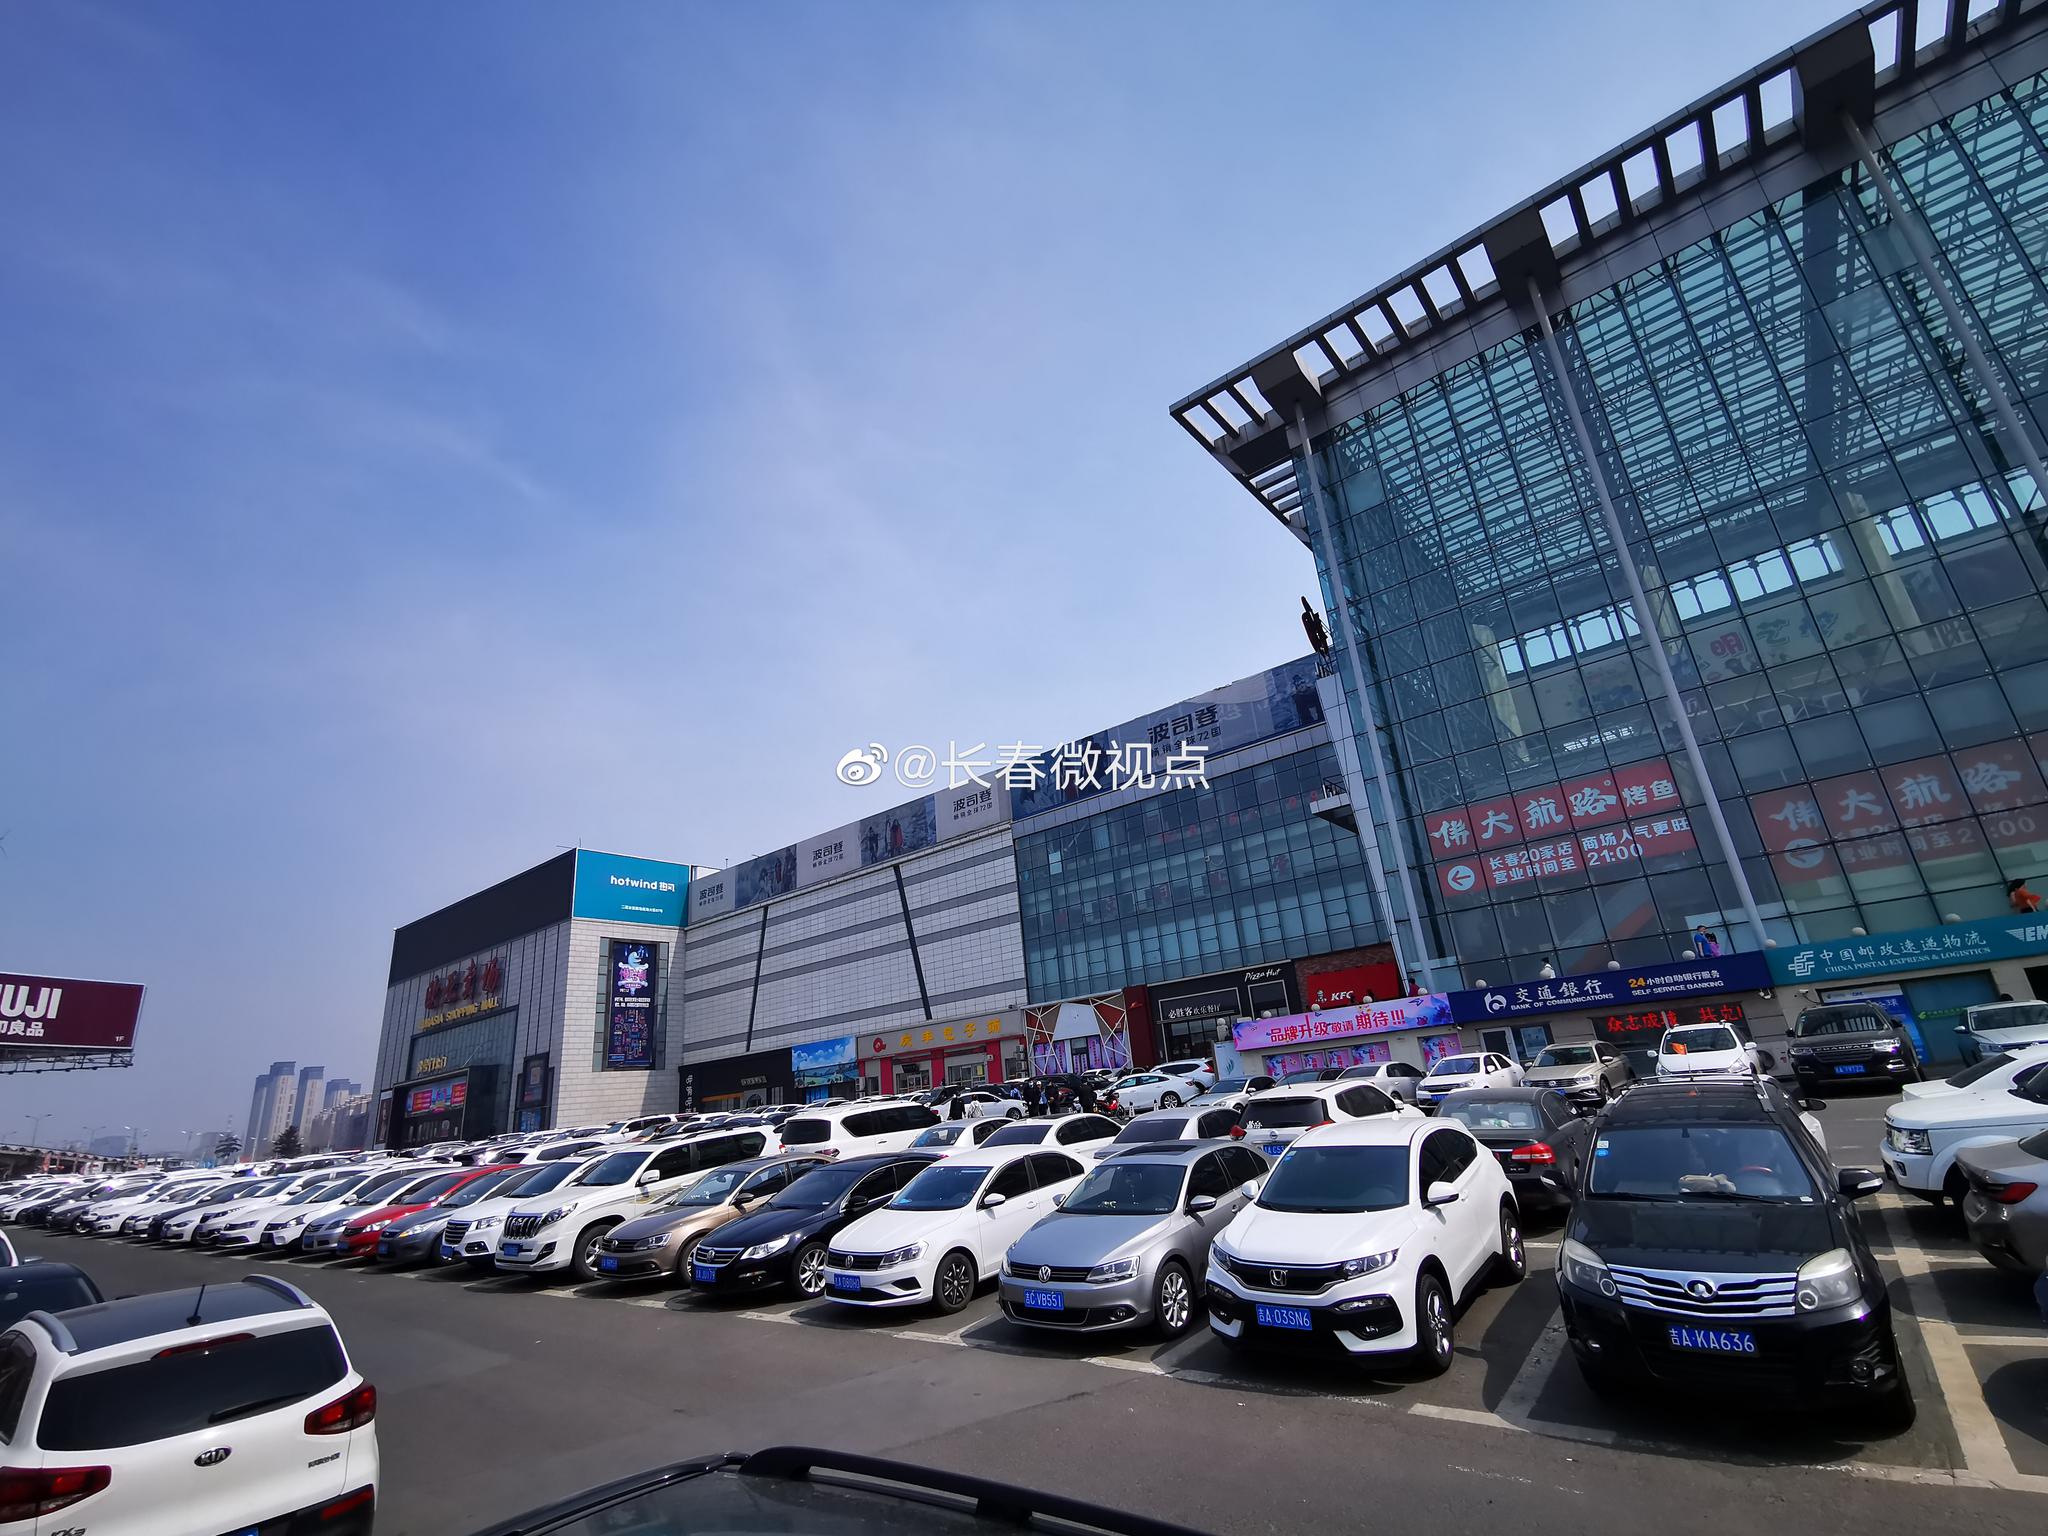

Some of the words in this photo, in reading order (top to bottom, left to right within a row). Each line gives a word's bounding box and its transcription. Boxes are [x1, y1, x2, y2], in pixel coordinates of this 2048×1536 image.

[1147, 704, 1219, 744] 波司登
[953, 788, 992, 812] 波司登
[1769, 762, 2021, 831] 伟大航路
[1430, 786, 1617, 848] 伟大航路
[1621, 778, 1679, 808] 烤鱼
[1956, 815, 2037, 844] 2:00
[812, 840, 844, 861] 波司登
[1488, 841, 1573, 870] 长春20家店
[1581, 817, 1690, 851] 商场人气更旺
[1492, 856, 1578, 885] 营业时间至
[1587, 844, 1643, 866] 21:00
[610, 875, 657, 890] hotwind
[1819, 930, 1987, 965] 中国邮政速递物流
[1825, 964, 1853, 974] CHINA
[1854, 959, 1887, 970] POSTAL
[1889, 955, 1928, 967] EXPRESS
[1940, 946, 1991, 959] LOGISTICS
[1244, 971, 1265, 982] Pizza
[1265, 968, 1281, 977] Hut
[1653, 984, 1686, 994] SERVICE
[1687, 980, 1724, 990] BANKING
[0, 984, 62, 1019] UJI
[481, 996, 499, 1008] MALL
[1331, 990, 1353, 1001] KFC
[1511, 1003, 1531, 1011] BANK
[1546, 993, 1614, 1008] COMMUNICATIONS
[201, 1449, 226, 1465] KIA
